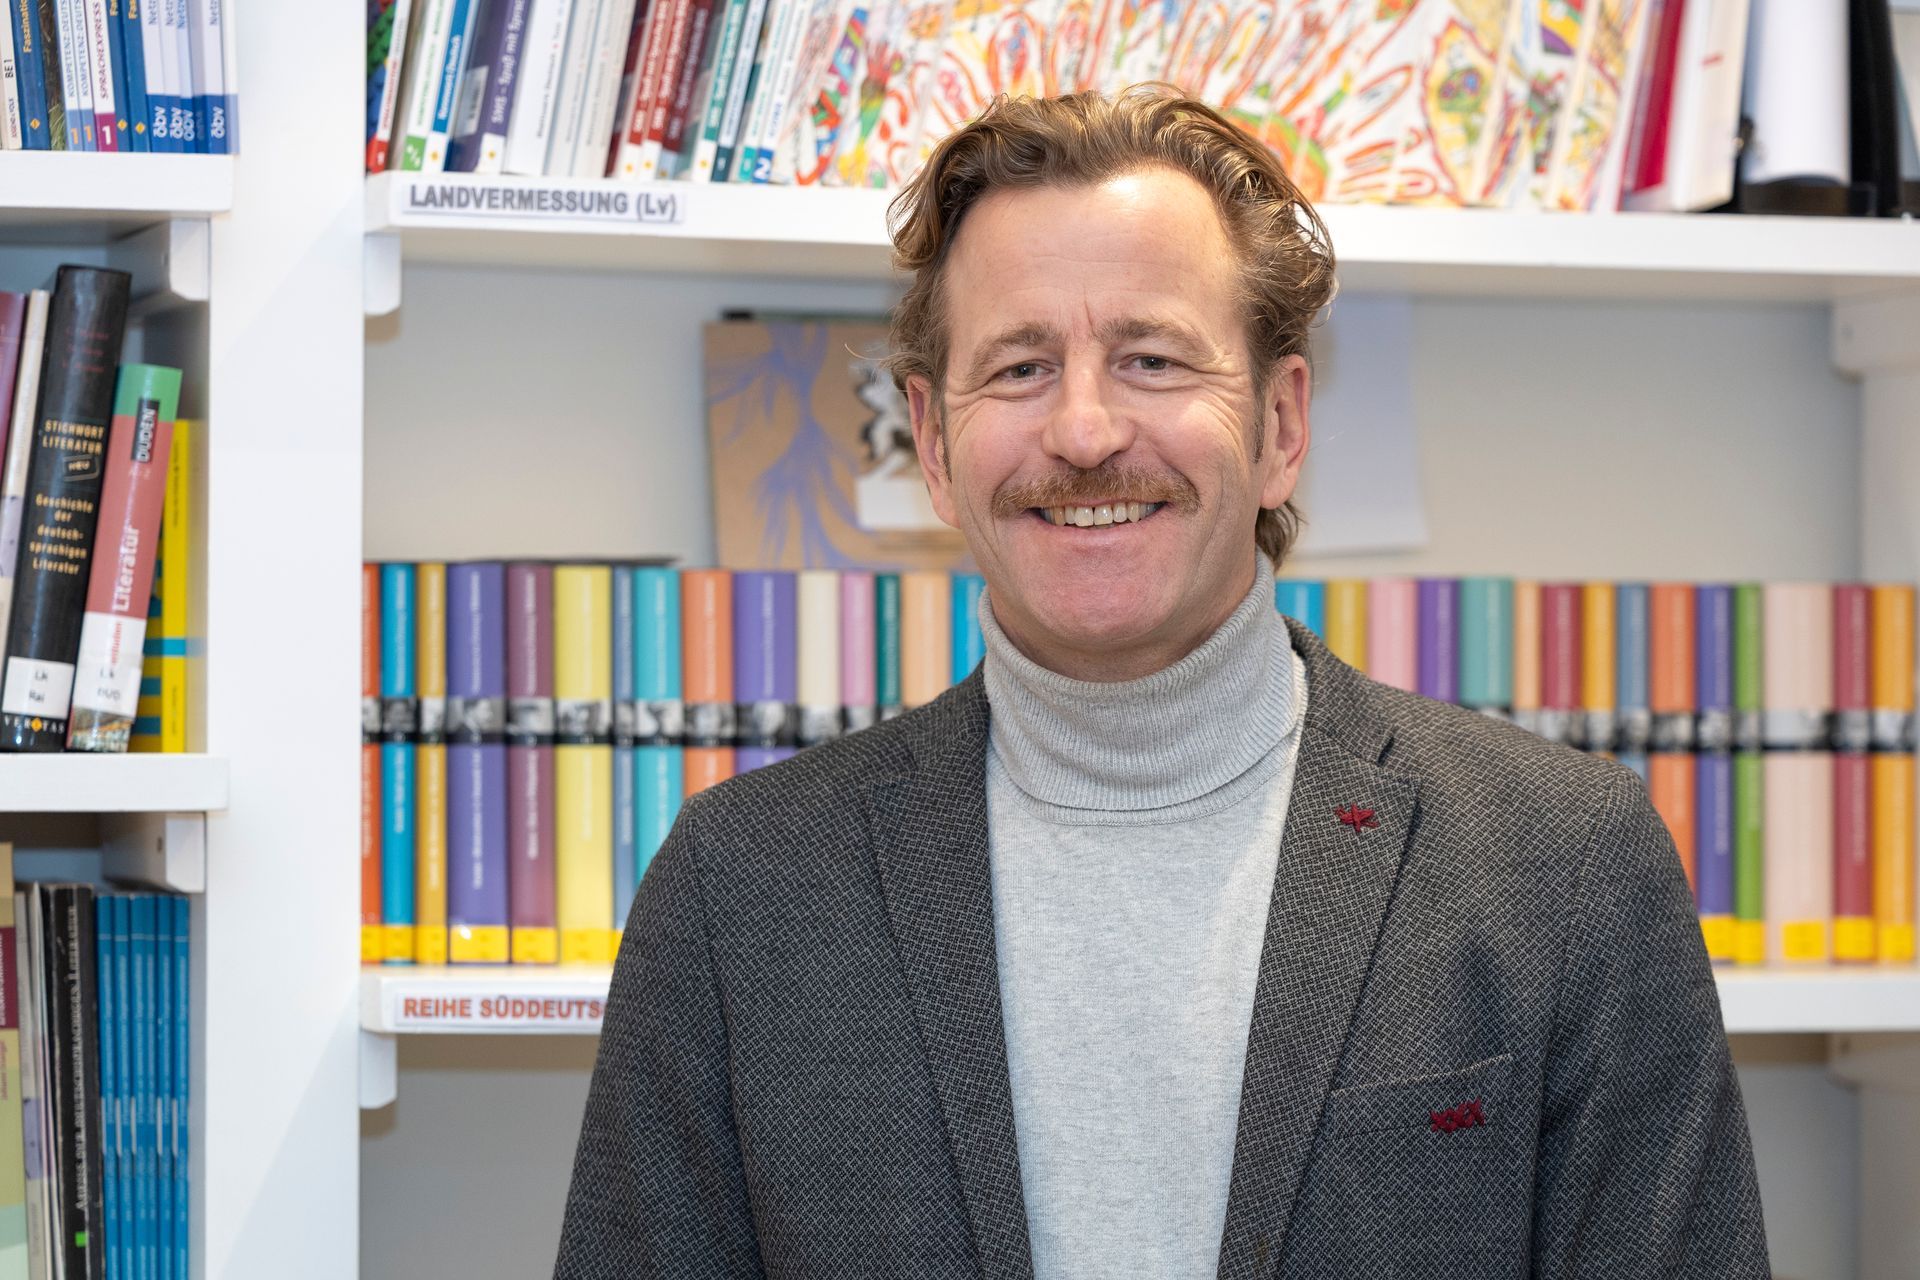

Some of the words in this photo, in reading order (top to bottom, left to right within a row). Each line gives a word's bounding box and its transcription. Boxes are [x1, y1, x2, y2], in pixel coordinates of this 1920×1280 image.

[102, 125, 112, 145] 1
[754, 157, 772, 180] 2
[410, 185, 628, 213] LANDVERMESSUNG
[637, 193, 677, 222] (Lv)
[44, 420, 105, 439] STICHWORT
[136, 408, 156, 463] DUDEN
[42, 435, 103, 455] LITERATUR
[35, 493, 94, 513] Geschichte
[54, 509, 73, 523] der
[37, 524, 84, 541] deutsch-
[29, 540, 88, 560] sprachigen
[32, 557, 80, 575] Literatur
[112, 524, 139, 612] Literatur
[4, 716, 66, 735] VERTAS
[403, 998, 472, 1018] REIHE
[480, 994, 607, 1020] SÜDDEUTS
